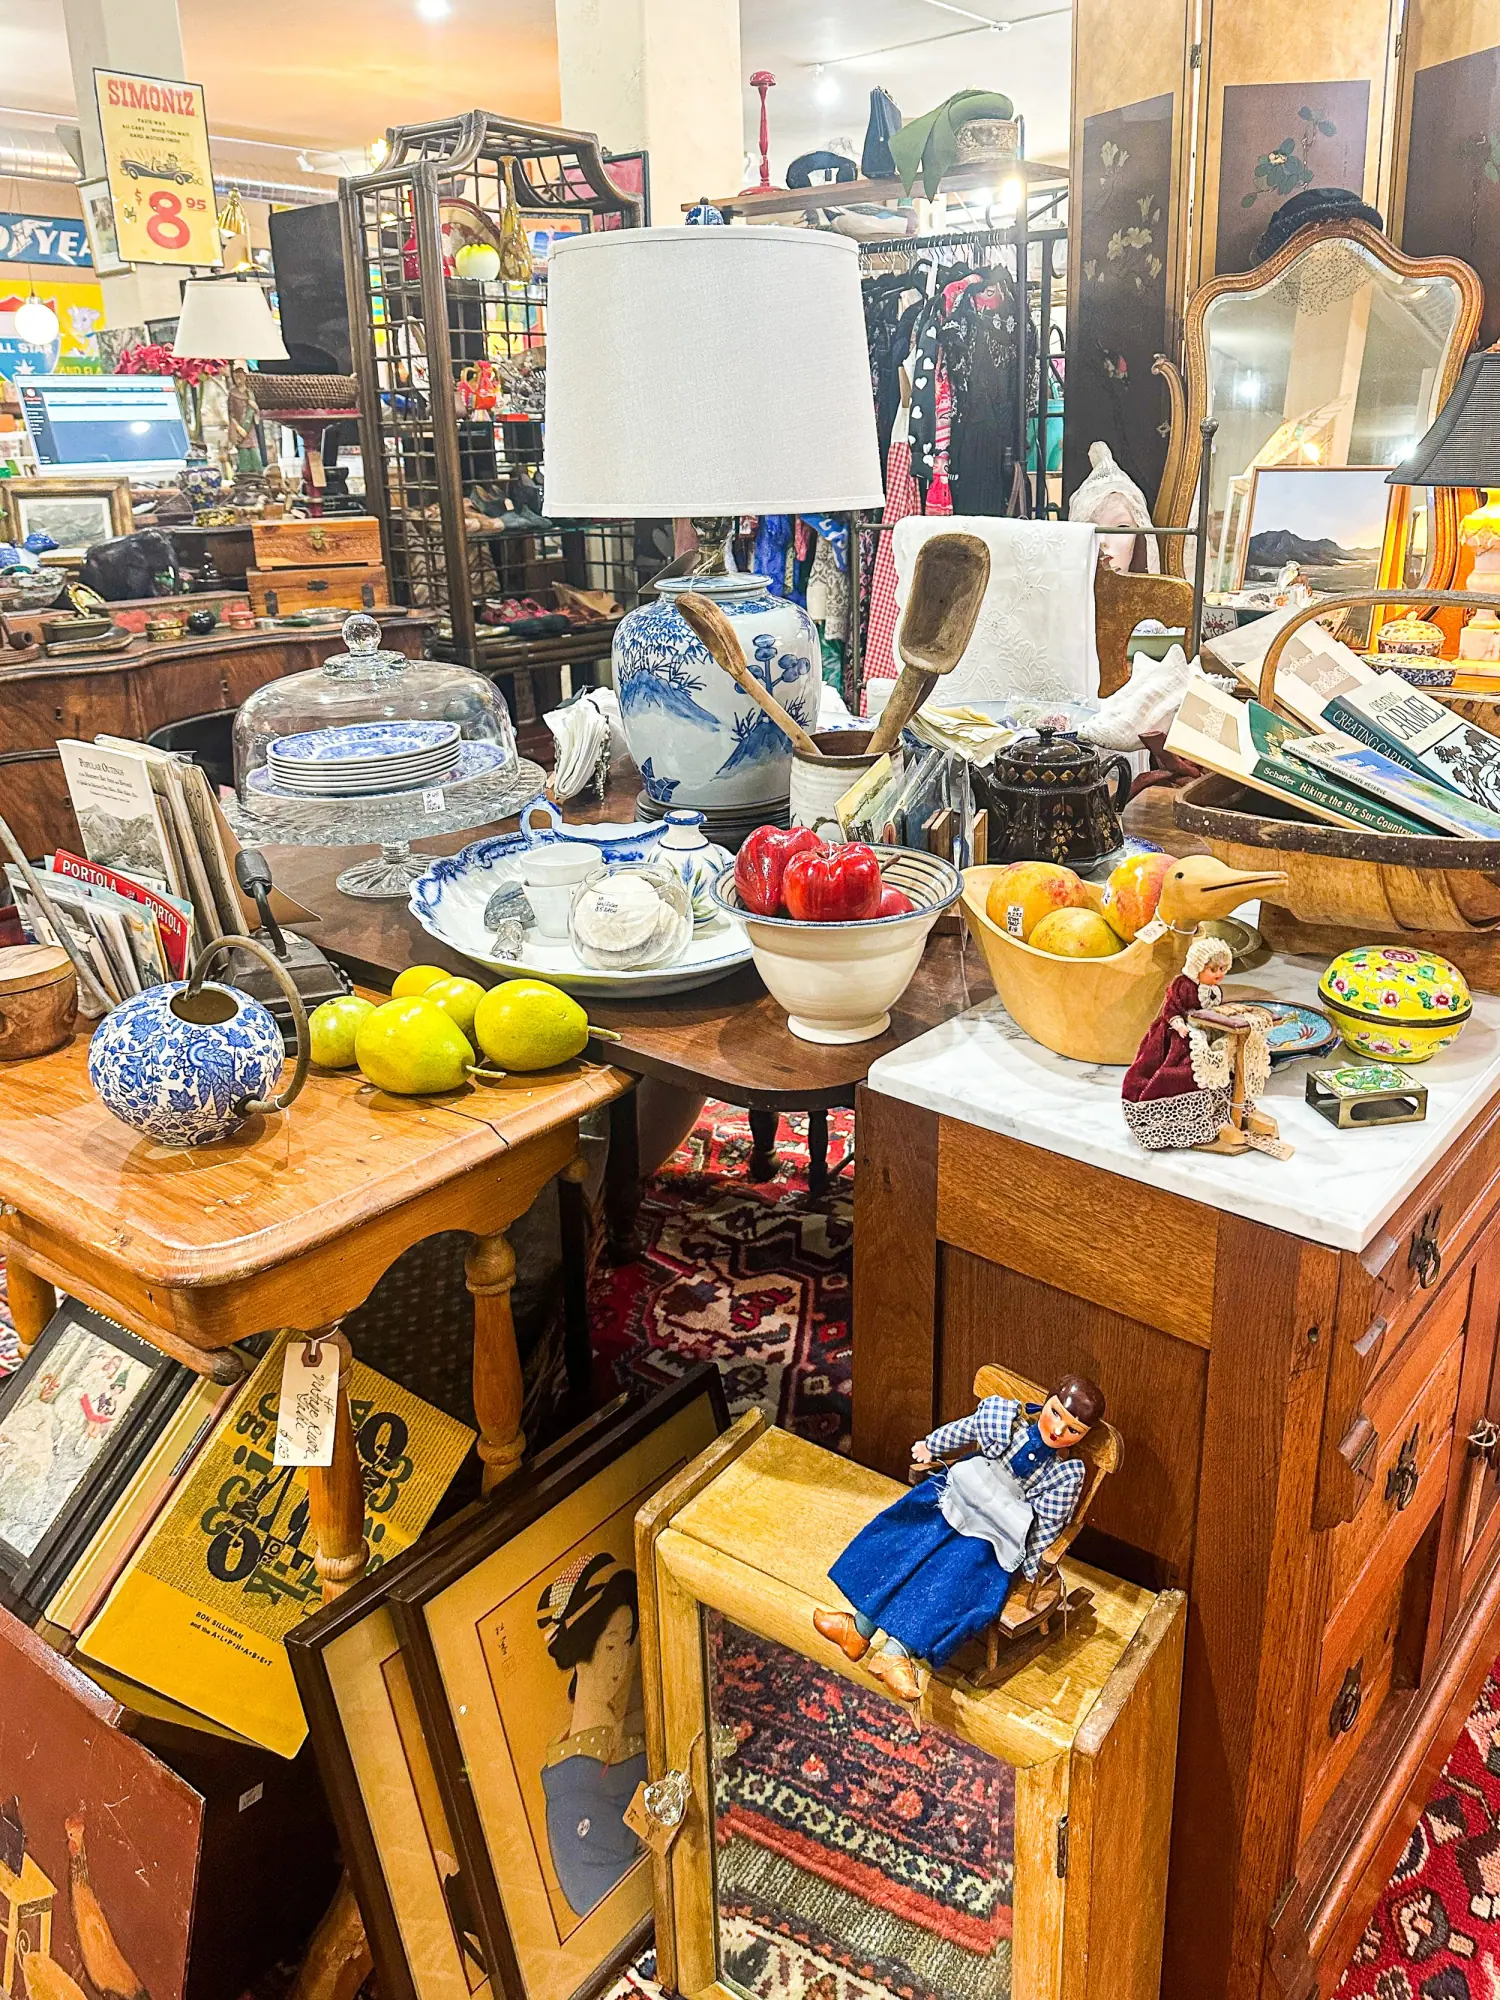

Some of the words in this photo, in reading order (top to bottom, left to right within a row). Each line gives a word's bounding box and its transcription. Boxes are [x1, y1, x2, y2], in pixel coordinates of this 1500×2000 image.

[108, 79, 195, 116] SIMONIZ
[1333, 710, 1379, 751] CREATING
[1376, 695, 1447, 741] CARMEL
[1263, 766, 1297, 786] Schaffer
[1300, 782, 1327, 803] Hiking
[1329, 795, 1343, 808] the
[1344, 802, 1358, 816] Big
[1360, 809, 1376, 822] Sur
[1316, 757, 1333, 770] POINT
[1332, 765, 1349, 778] LOBOS
[1349, 773, 1364, 785] STATE
[1363, 778, 1388, 796] RESERVE
[62, 859, 118, 893] PORTOLA
[145, 896, 181, 936] PORTOLA
[190, 1621, 201, 1630] and
[201, 1626, 211, 1635] the
[195, 1611, 211, 1623] RON
[211, 1619, 244, 1640] SILLIMAN
